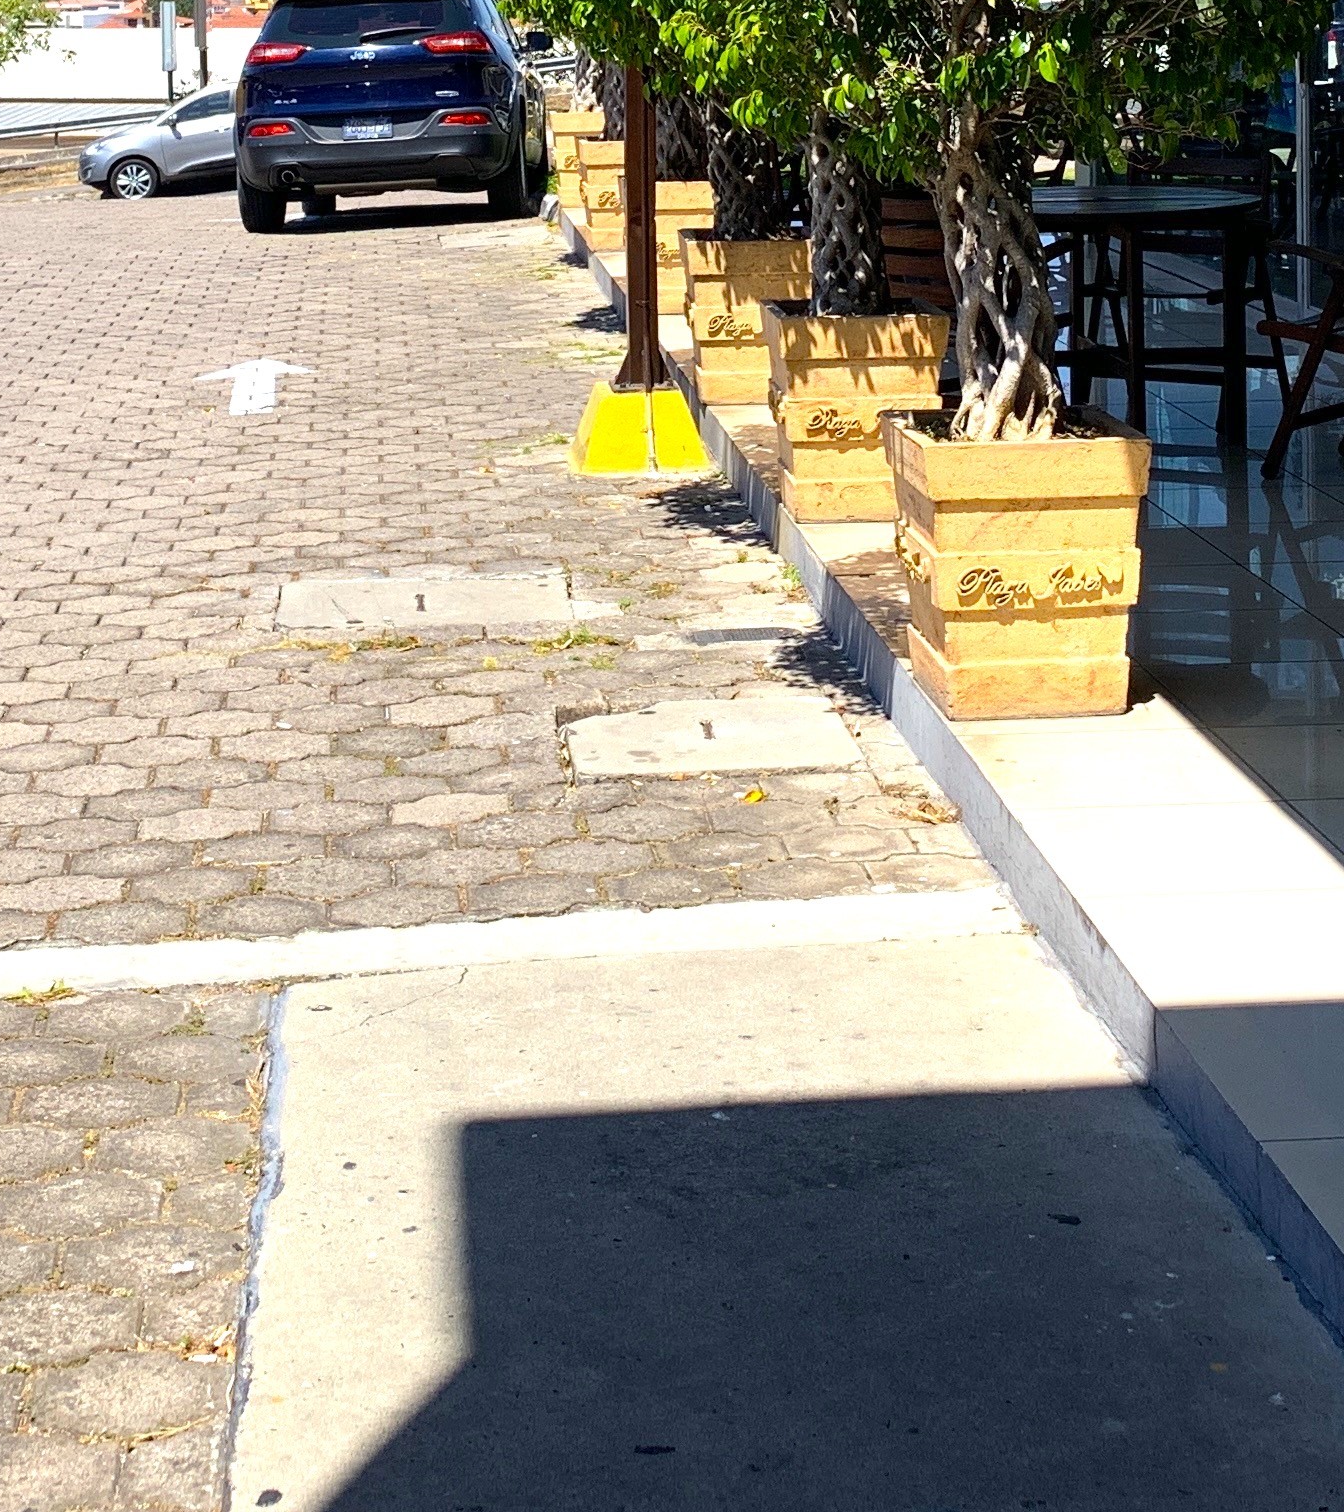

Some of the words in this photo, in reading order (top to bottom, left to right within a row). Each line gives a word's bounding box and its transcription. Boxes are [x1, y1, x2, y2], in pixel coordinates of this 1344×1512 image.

[349, 50, 375, 61] Jeep
[707, 313, 752, 337] Plaza
[806, 407, 862, 438] Plaza
[956, 565, 1029, 606] Plaza
